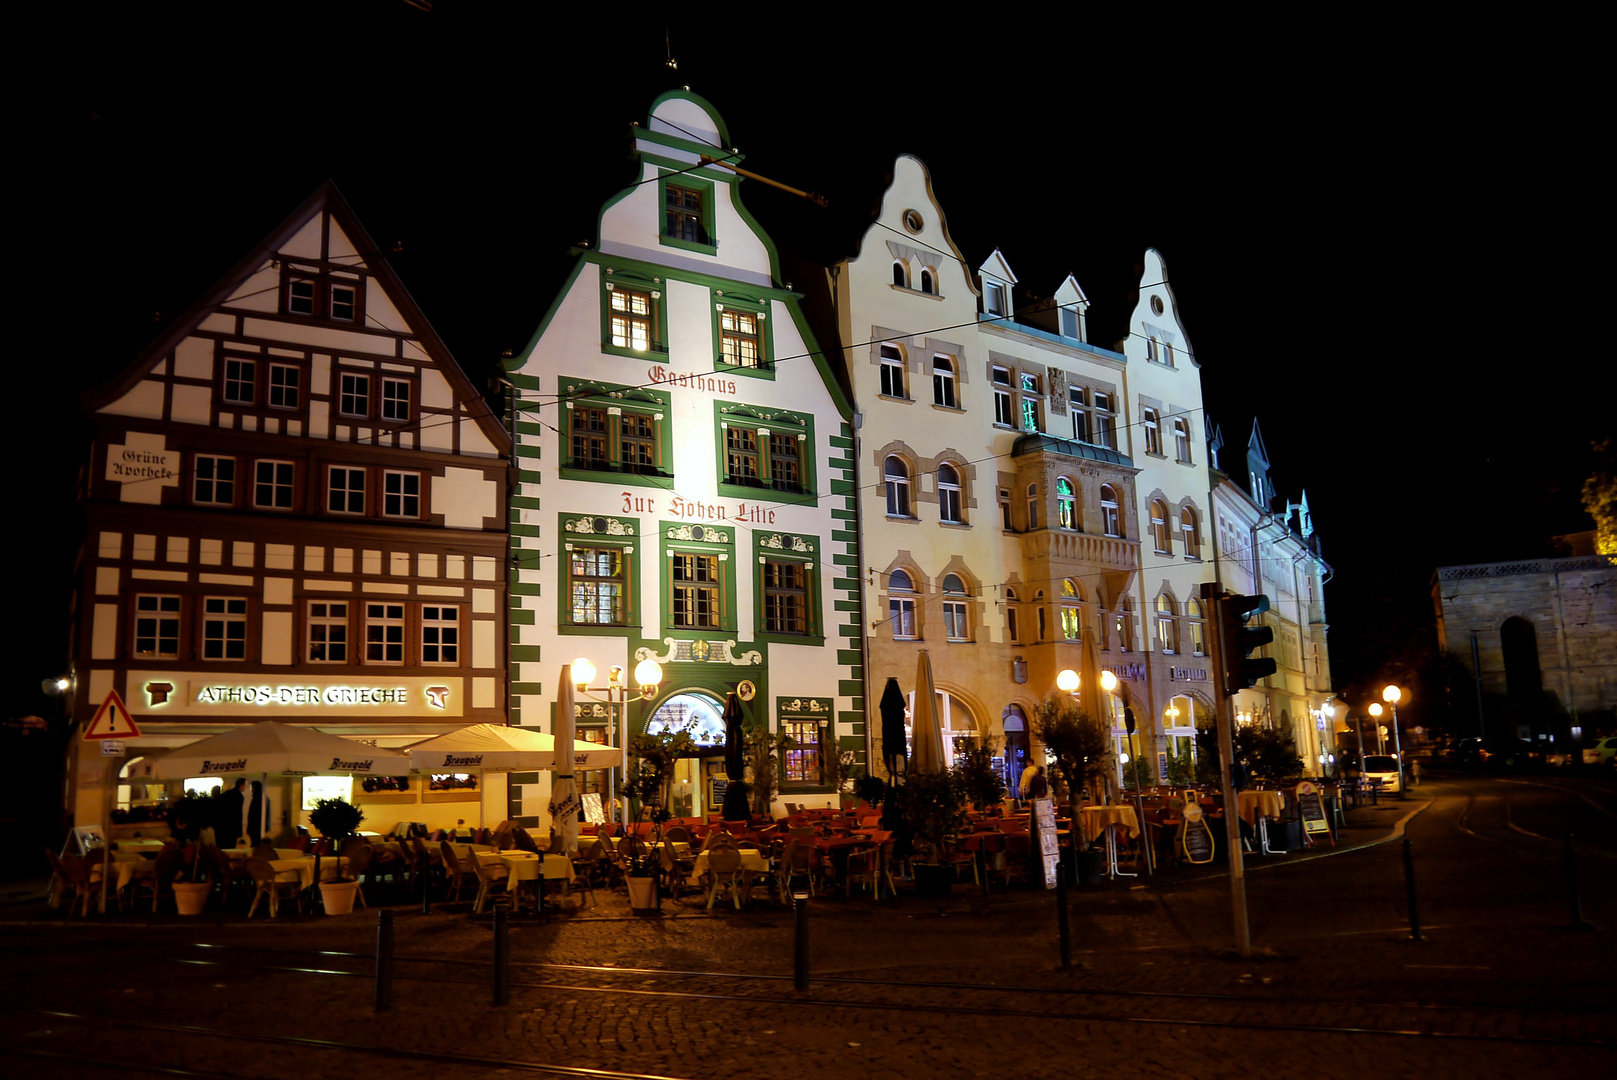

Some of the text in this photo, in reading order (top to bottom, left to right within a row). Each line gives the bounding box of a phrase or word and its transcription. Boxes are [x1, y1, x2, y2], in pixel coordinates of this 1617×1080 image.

[647, 365, 737, 395] Gasthaus
[122, 449, 166, 465] Grüne
[113, 462, 172, 479] Apotheke
[621, 491, 776, 525] Zur Hohen Lilie
[327, 688, 408, 703] GRIECHE
[200, 758, 248, 773] Braugold
[329, 757, 374, 771] Braugold
[443, 754, 483, 767] Braugold
